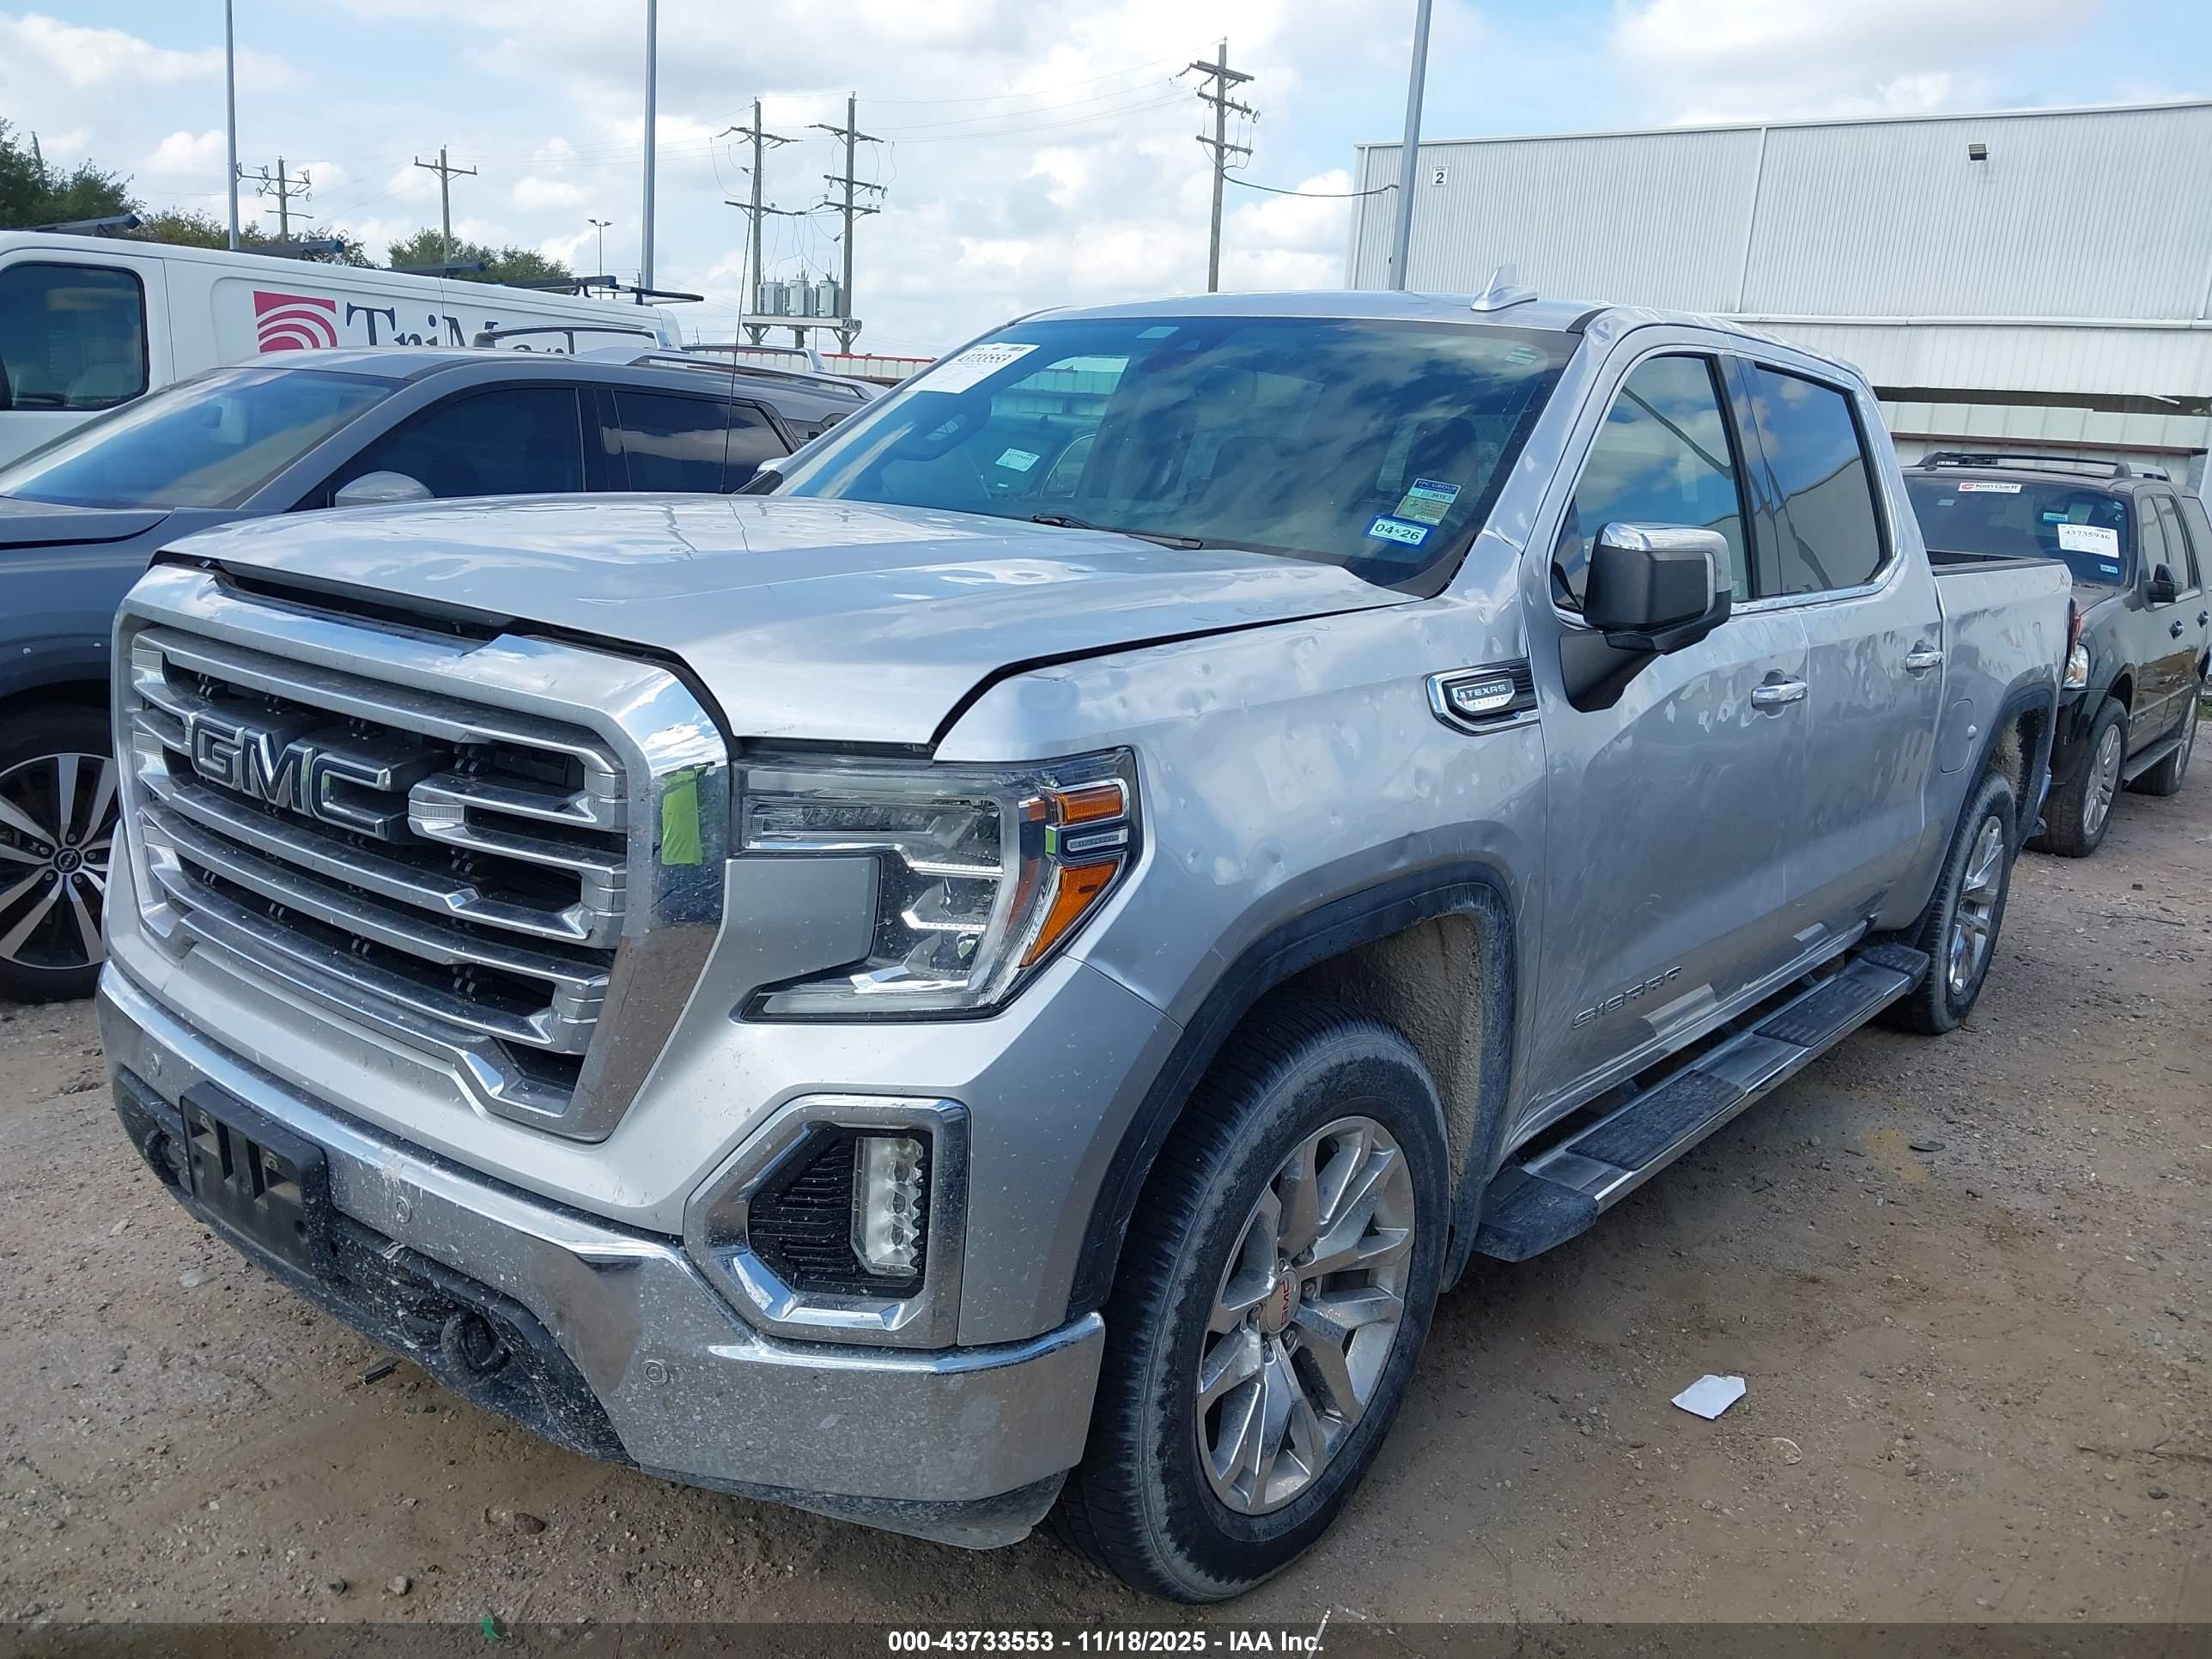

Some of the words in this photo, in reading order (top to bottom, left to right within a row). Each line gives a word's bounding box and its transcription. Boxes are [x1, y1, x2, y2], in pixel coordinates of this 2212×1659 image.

[1436, 172, 1444, 184] 2
[1375, 524, 1395, 534] 04
[1401, 529, 1420, 541] 26
[2064, 530, 2111, 540] 43735946
[1466, 684, 1506, 697] TEXAS
[191, 714, 392, 841] GMC
[1573, 965, 1683, 1030] SIERRA
[1280, 1277, 1290, 1326] GMC
